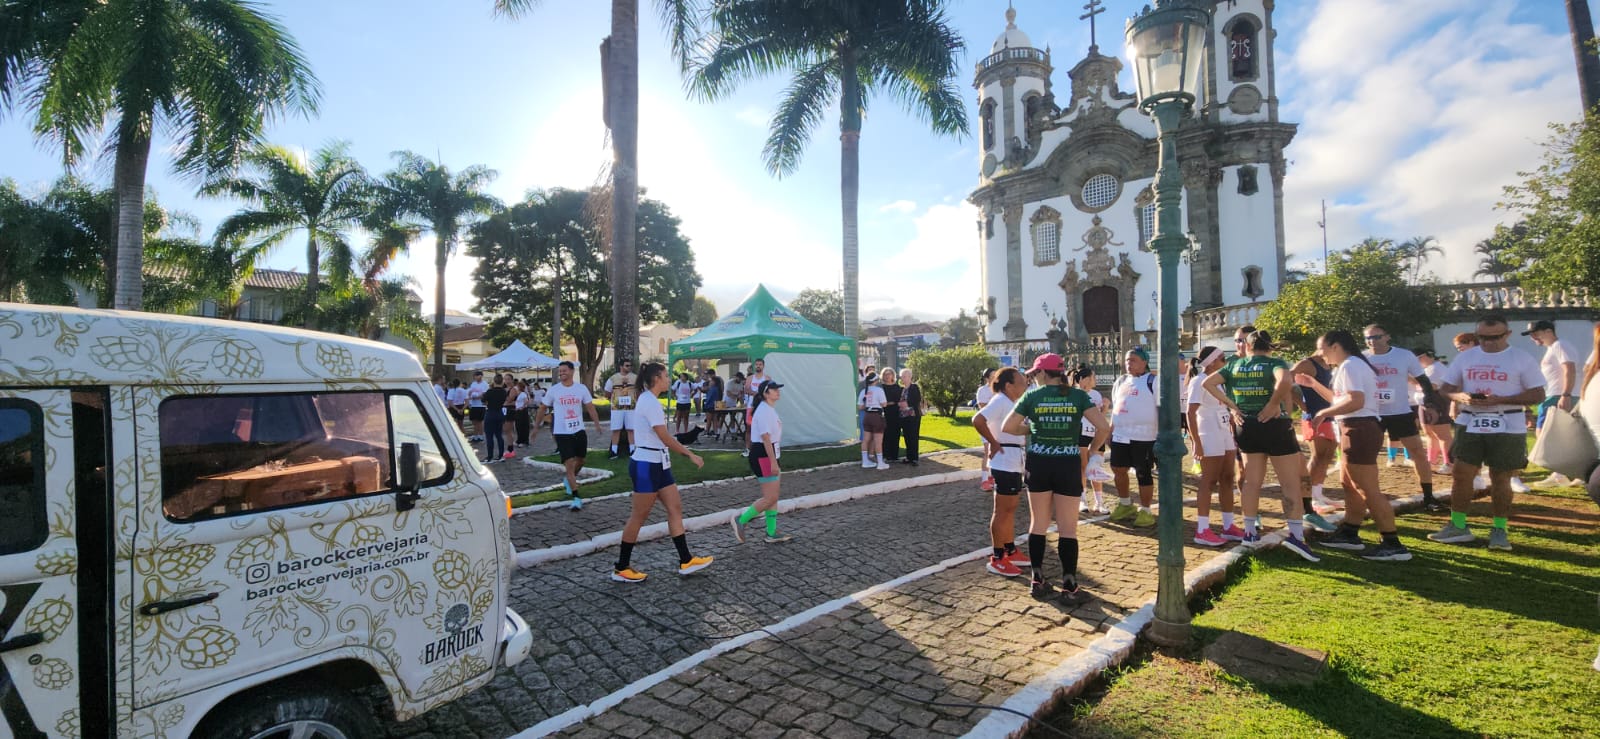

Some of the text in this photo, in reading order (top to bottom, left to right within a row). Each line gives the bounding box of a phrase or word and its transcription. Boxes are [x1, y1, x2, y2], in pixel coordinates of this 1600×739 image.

[1467, 368, 1508, 381] Trata
[1472, 419, 1500, 428] 158
[277, 533, 428, 574] barockcervejaria
[246, 551, 430, 600] barockcervejaria.com.br
[425, 624, 484, 665] BAROCK
